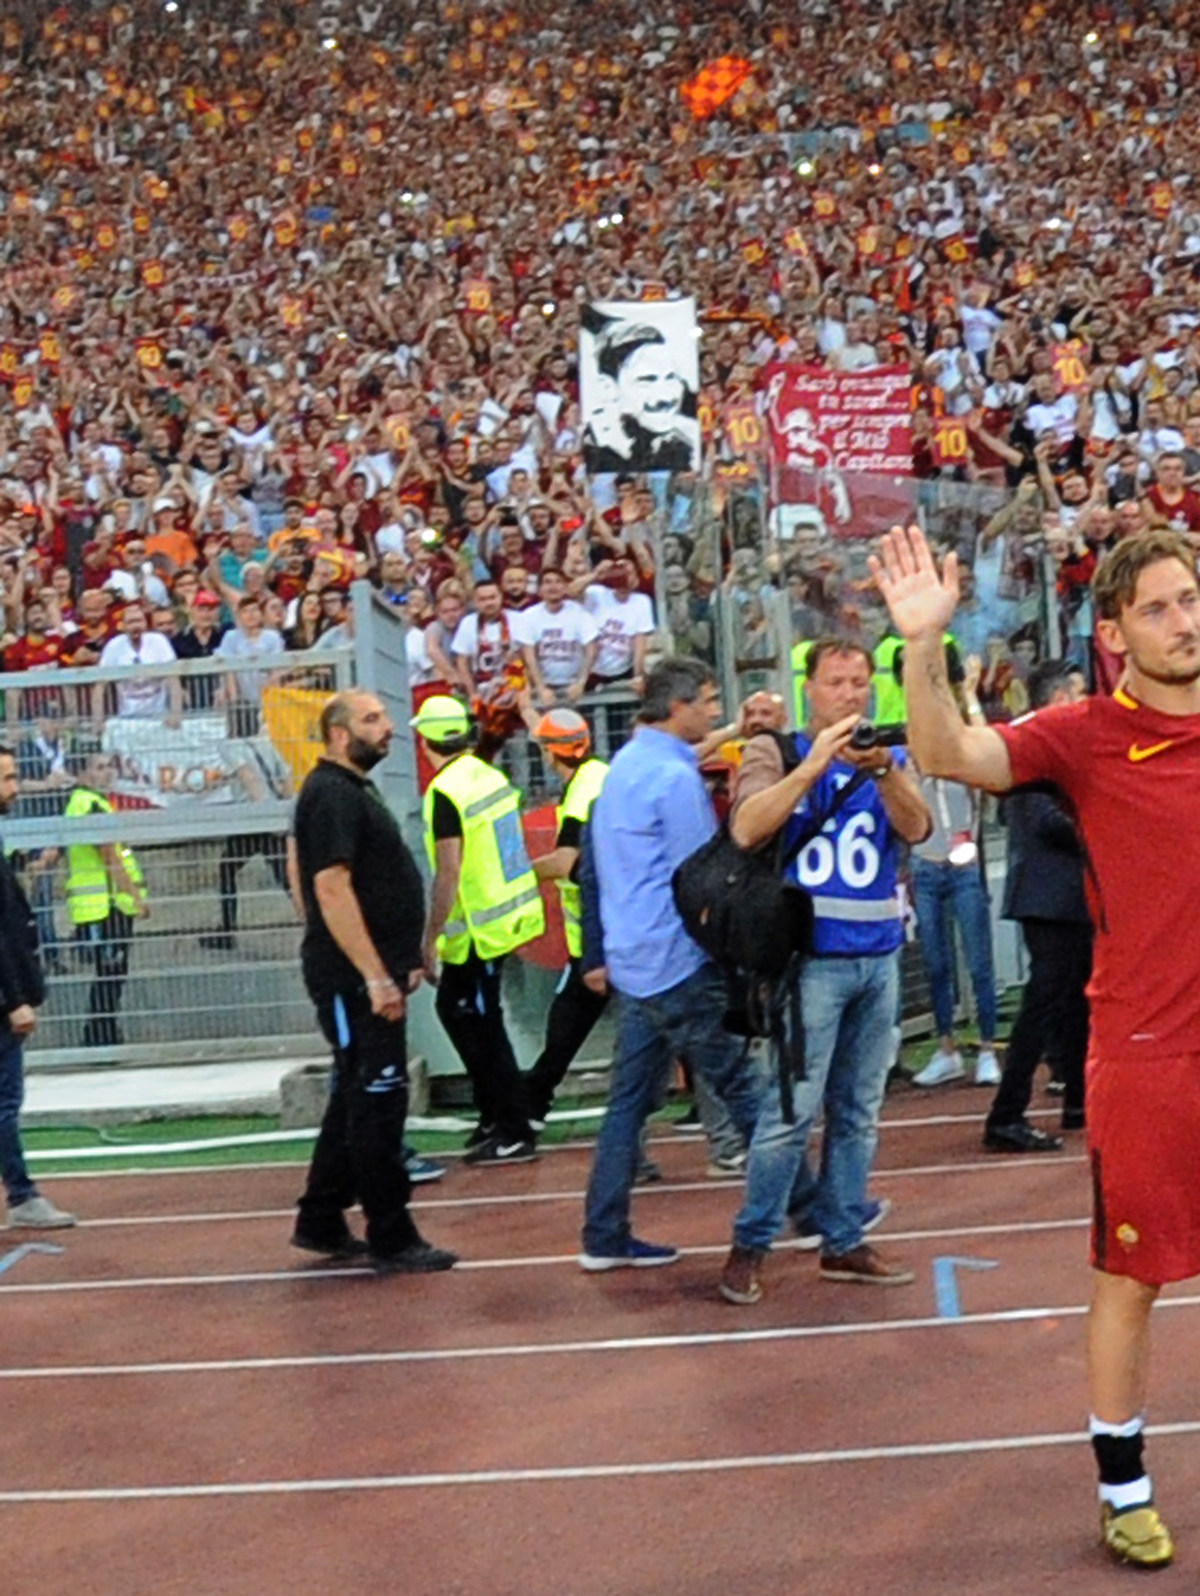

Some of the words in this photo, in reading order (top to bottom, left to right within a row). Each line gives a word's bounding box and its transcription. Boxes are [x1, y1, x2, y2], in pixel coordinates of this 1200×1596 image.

[1053, 357, 1085, 385] 10
[726, 415, 760, 451] 10
[934, 428, 968, 458] 10
